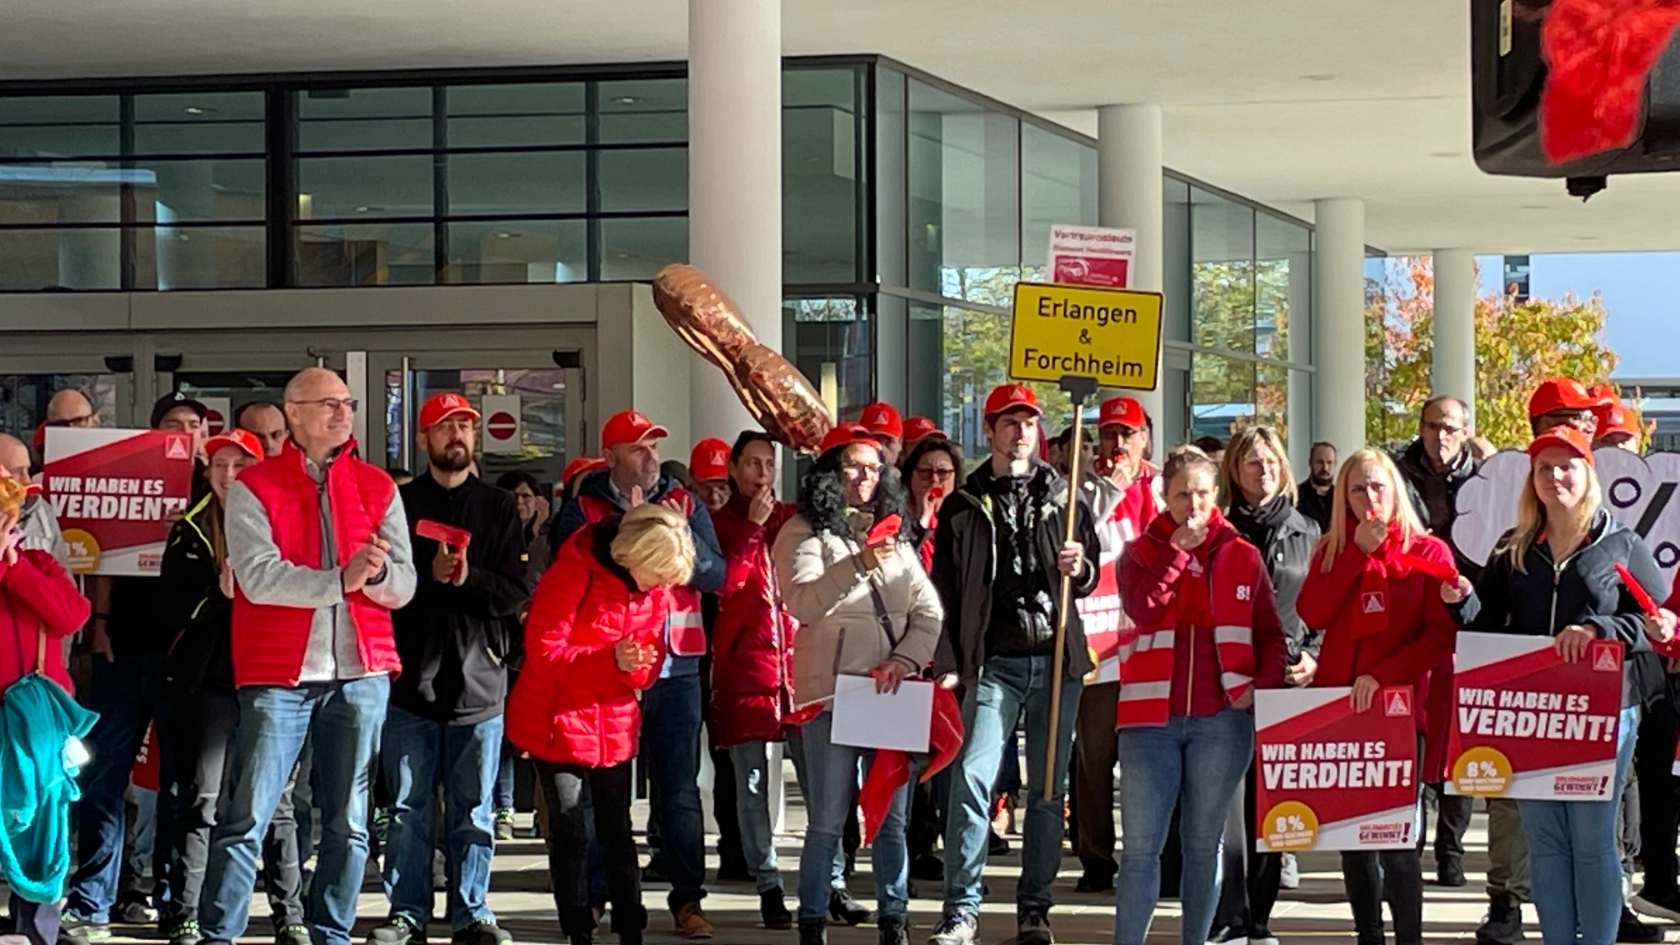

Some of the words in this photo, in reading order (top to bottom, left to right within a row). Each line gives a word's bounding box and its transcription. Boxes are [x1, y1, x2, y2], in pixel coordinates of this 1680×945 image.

[1038, 296, 1137, 327] Erlangen
[1079, 328, 1092, 345] &
[1024, 348, 1143, 377] Forchheim
[50, 476, 81, 492] WIR
[85, 477, 140, 494] HABEN
[143, 479, 164, 495] ES
[1236, 585, 1250, 601] 8!
[1459, 687, 1496, 707] WIR
[1499, 690, 1563, 710] HABEN
[1566, 695, 1589, 712] ES
[1458, 707, 1616, 742] VERDIENT!
[1261, 743, 1297, 761] WIR
[1301, 742, 1359, 760] HABEN
[1364, 741, 1386, 758] ES
[1263, 760, 1413, 789] VERDIENT!
